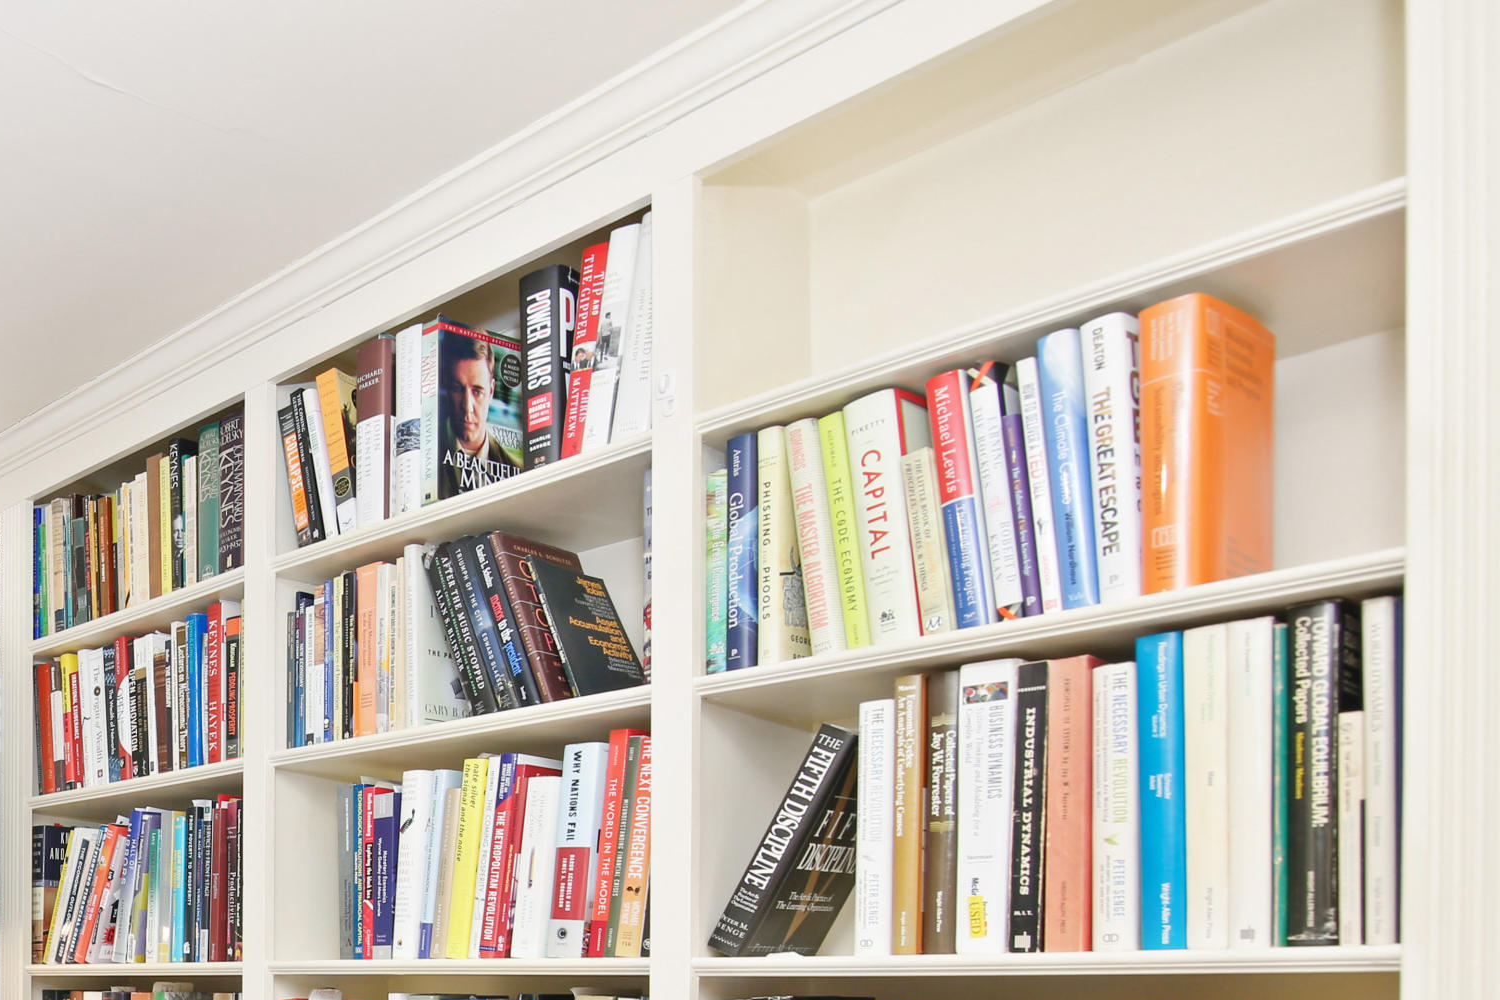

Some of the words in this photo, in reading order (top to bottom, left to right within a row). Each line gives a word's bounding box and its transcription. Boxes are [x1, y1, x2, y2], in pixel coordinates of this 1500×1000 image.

[581, 253, 595, 285] THE
[590, 271, 604, 296] TIP
[525, 288, 551, 345] POWER
[575, 287, 591, 340] GIPPER
[590, 299, 601, 315] AND
[526, 345, 552, 391] WARS
[1091, 327, 1107, 371] DEATON
[566, 377, 580, 439] MATTHEWS
[579, 388, 590, 424] CHRIS
[932, 384, 955, 447] Michael
[1092, 387, 1112, 423] THE
[941, 450, 959, 494] Lewis
[1094, 423, 1116, 484] GREAT
[219, 453, 233, 528] KEYNES
[793, 483, 814, 510] THE
[831, 478, 843, 505] THE
[861, 449, 891, 560] CAPITAL
[728, 492, 743, 540] Global
[761, 481, 772, 547] PHISHING
[834, 510, 849, 545] CODE
[1100, 485, 1120, 557] ESCAPE
[798, 511, 821, 559] MASTER
[440, 556, 457, 587] AFTER
[727, 544, 744, 630] Production
[840, 550, 857, 612] ECONOMY
[448, 589, 463, 610] THE
[488, 593, 506, 622] memos
[761, 566, 771, 621] PHOOLS
[803, 561, 830, 632] ALGORITHM
[435, 590, 448, 616] ALAN
[445, 628, 465, 673] BLINDER
[457, 613, 474, 644] MUSIC
[496, 620, 509, 631] to
[499, 629, 514, 644] the
[178, 645, 187, 672] Lectures
[209, 619, 218, 677] KEYNES
[502, 641, 524, 677] president
[128, 668, 137, 696] OPEN
[227, 671, 237, 701] PEDDLING
[466, 646, 486, 690] STOPPED
[1111, 671, 1128, 691] THE
[129, 698, 139, 752] INNOVATION
[179, 683, 187, 730] Microeconomic
[209, 700, 218, 751] HAYEK
[227, 702, 237, 736] PROSPERITY
[1111, 693, 1128, 754] NECESSARY
[178, 731, 187, 752] Theory
[640, 739, 652, 760] THE
[817, 734, 843, 750] THE
[930, 732, 944, 752] Jay
[931, 751, 944, 764] W.
[944, 730, 957, 772] Collected
[1021, 707, 1038, 808] INDUSTRIAL
[571, 750, 583, 774] WHY
[638, 763, 651, 792] NEXT
[791, 745, 837, 802] FIFTH
[567, 779, 580, 817] NATIONS
[607, 778, 618, 797] THE
[931, 765, 945, 817] Forrester
[942, 772, 957, 804] Papers
[1111, 759, 1129, 824] REVOLUTION
[496, 811, 506, 826] THE
[603, 801, 616, 839] WORLD
[945, 806, 956, 816] of
[565, 822, 577, 842] FAIL
[602, 842, 613, 853] IN
[626, 796, 651, 879] CONVERGENCE
[744, 798, 809, 890] DISCIPLINE
[487, 828, 505, 890] METROPOLITAN
[600, 858, 612, 875] THE
[1019, 811, 1033, 896] DYNAMICS
[482, 891, 500, 941] REVOLUTION
[597, 879, 609, 915] MODEL
[970, 902, 982, 935] USED
